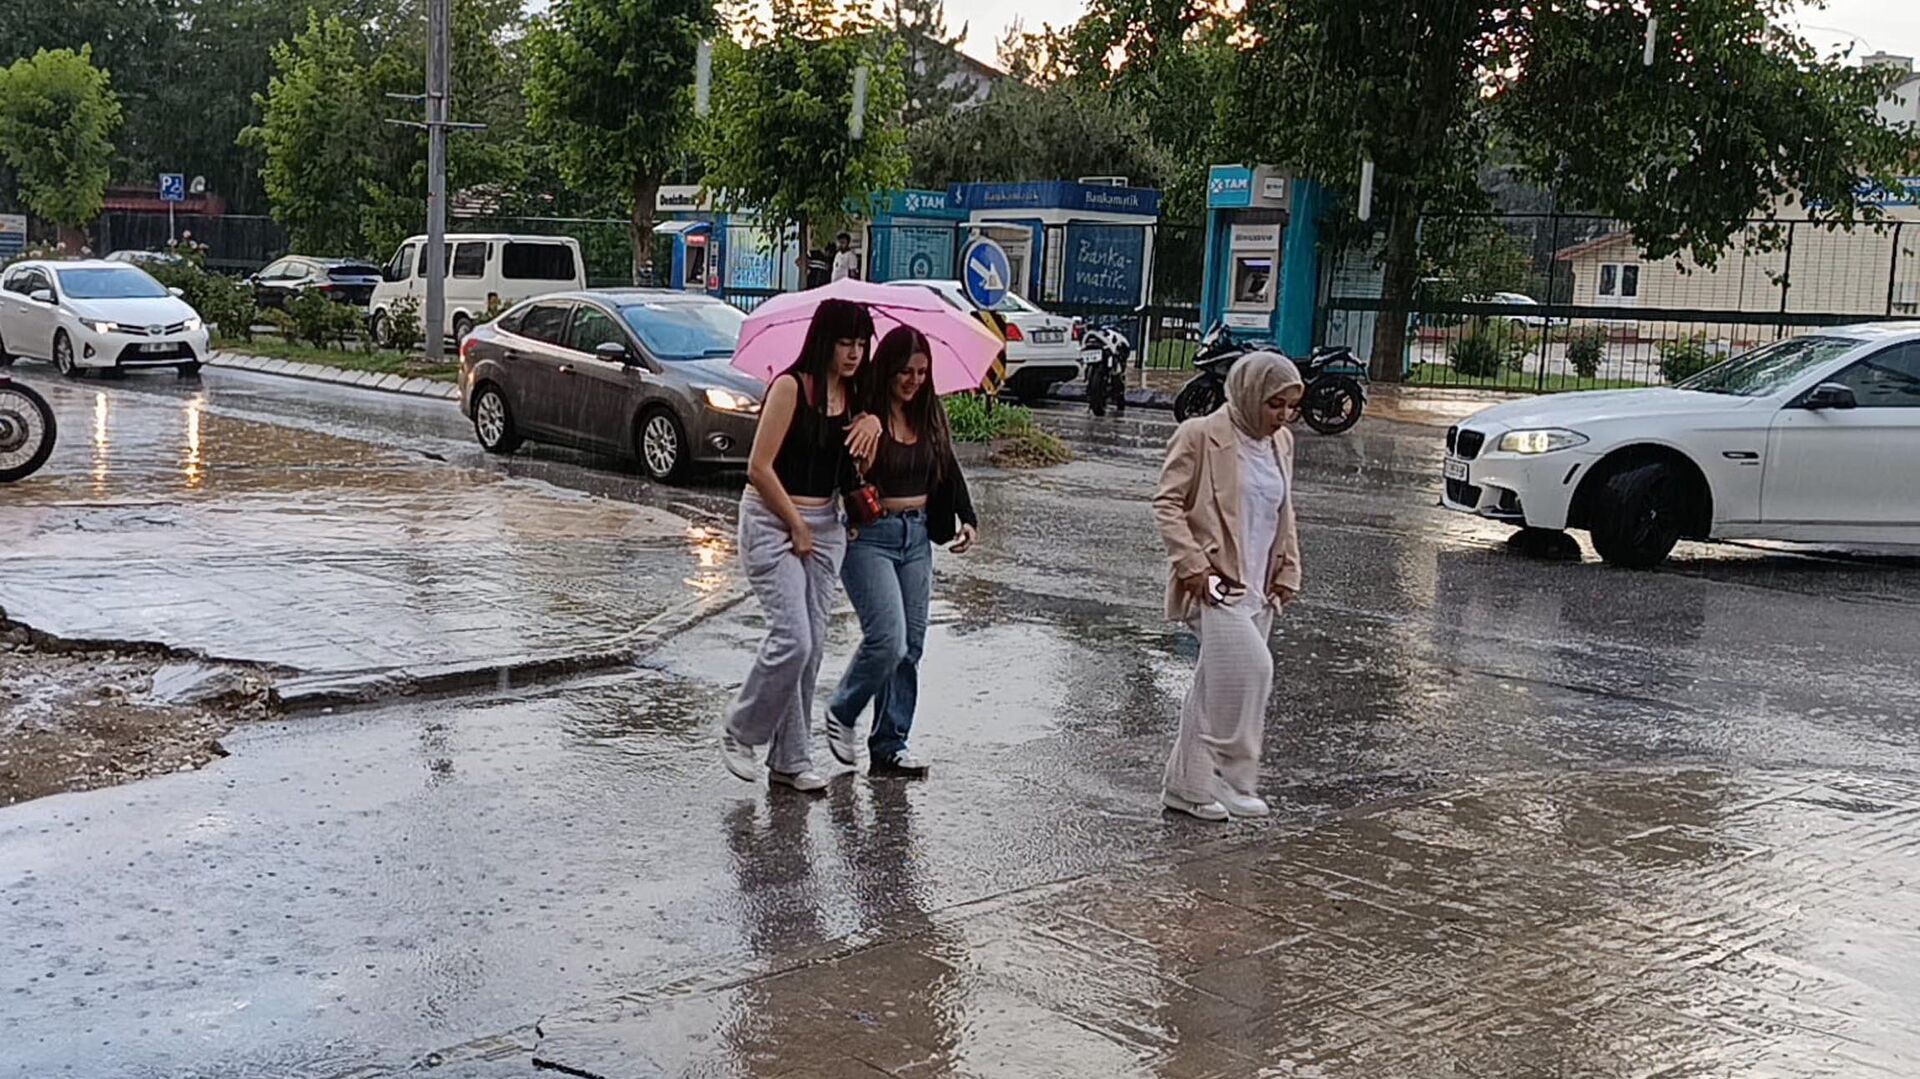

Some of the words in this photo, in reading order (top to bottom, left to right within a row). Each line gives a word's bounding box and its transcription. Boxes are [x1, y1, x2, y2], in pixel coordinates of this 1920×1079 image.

[1224, 178, 1249, 189] TAM
[920, 195, 945, 209] TAM
[1085, 191, 1138, 207] Bankamatik
[1078, 239, 1132, 268] Banka-
